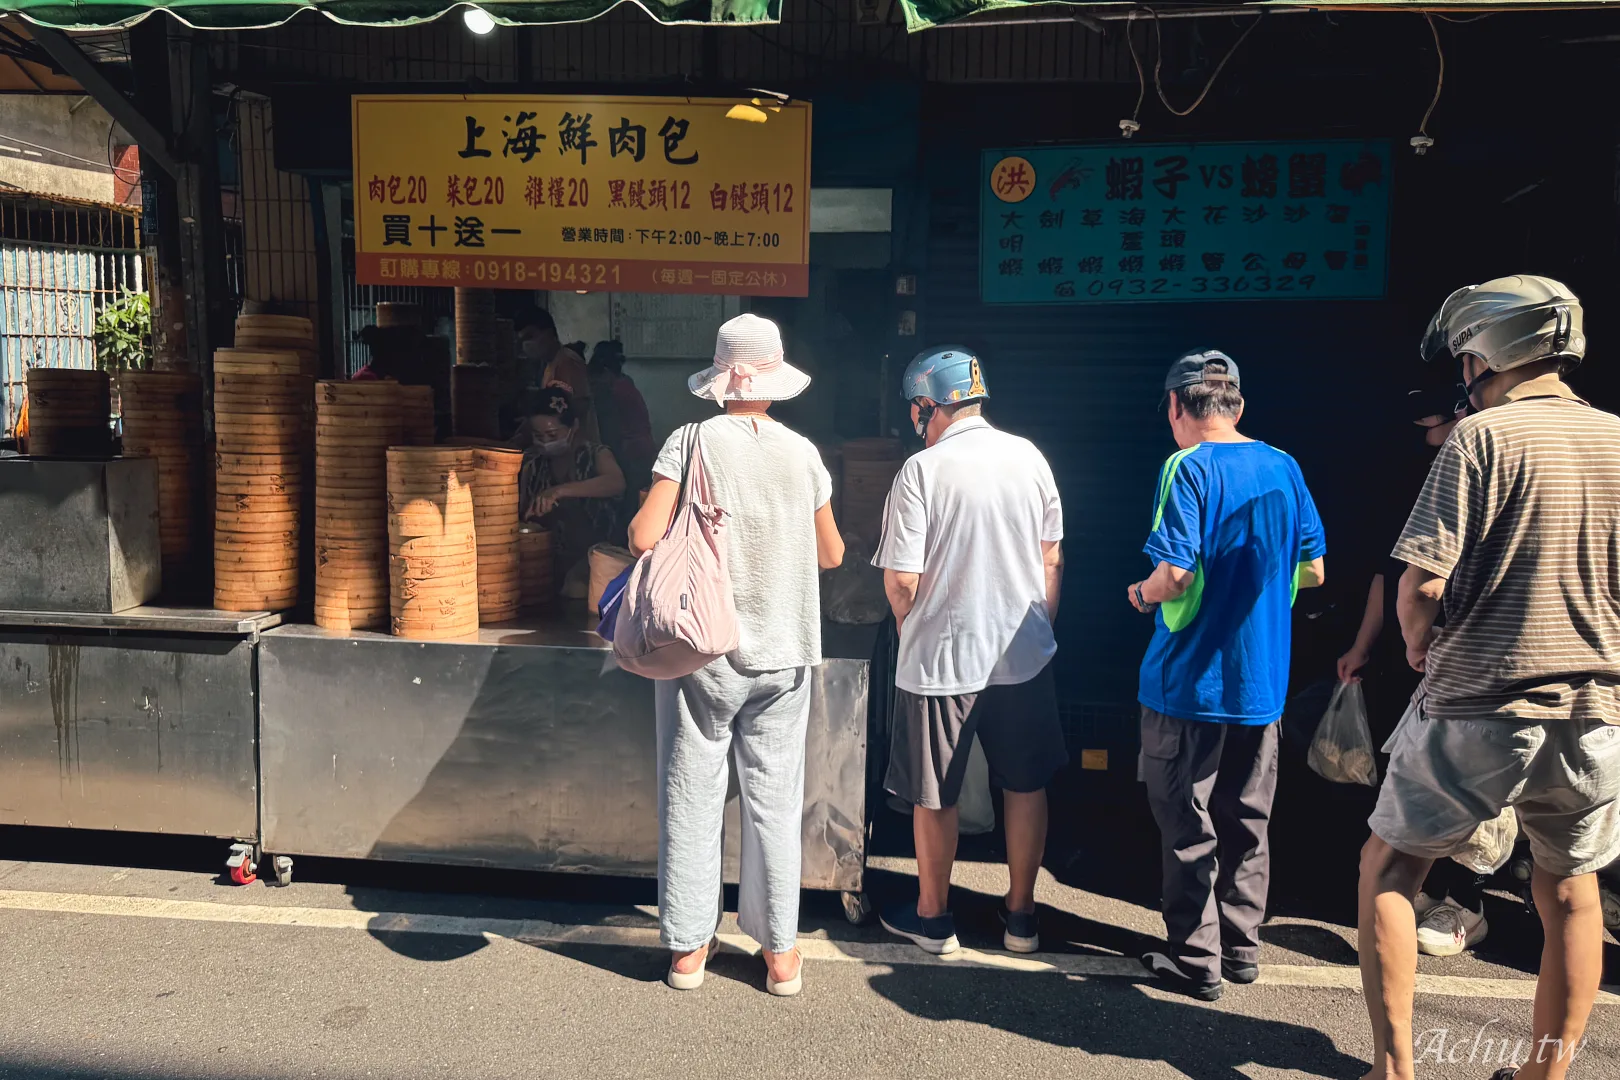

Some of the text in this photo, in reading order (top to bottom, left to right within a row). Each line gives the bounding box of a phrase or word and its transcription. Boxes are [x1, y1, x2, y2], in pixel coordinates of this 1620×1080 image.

[457, 111, 700, 166] 上海鮮肉包
[368, 175, 428, 206] 肉包20
[445, 175, 505, 206] 菜包20
[606, 178, 691, 212] 黑饅頭12
[709, 182, 794, 214] 白饅頭12
[997, 163, 1030, 195] 洪
[1105, 155, 1190, 201] 蝦子
[1198, 164, 1234, 189] VS
[381, 214, 523, 248] 買十送一
[1452, 327, 1473, 352] SUPA
